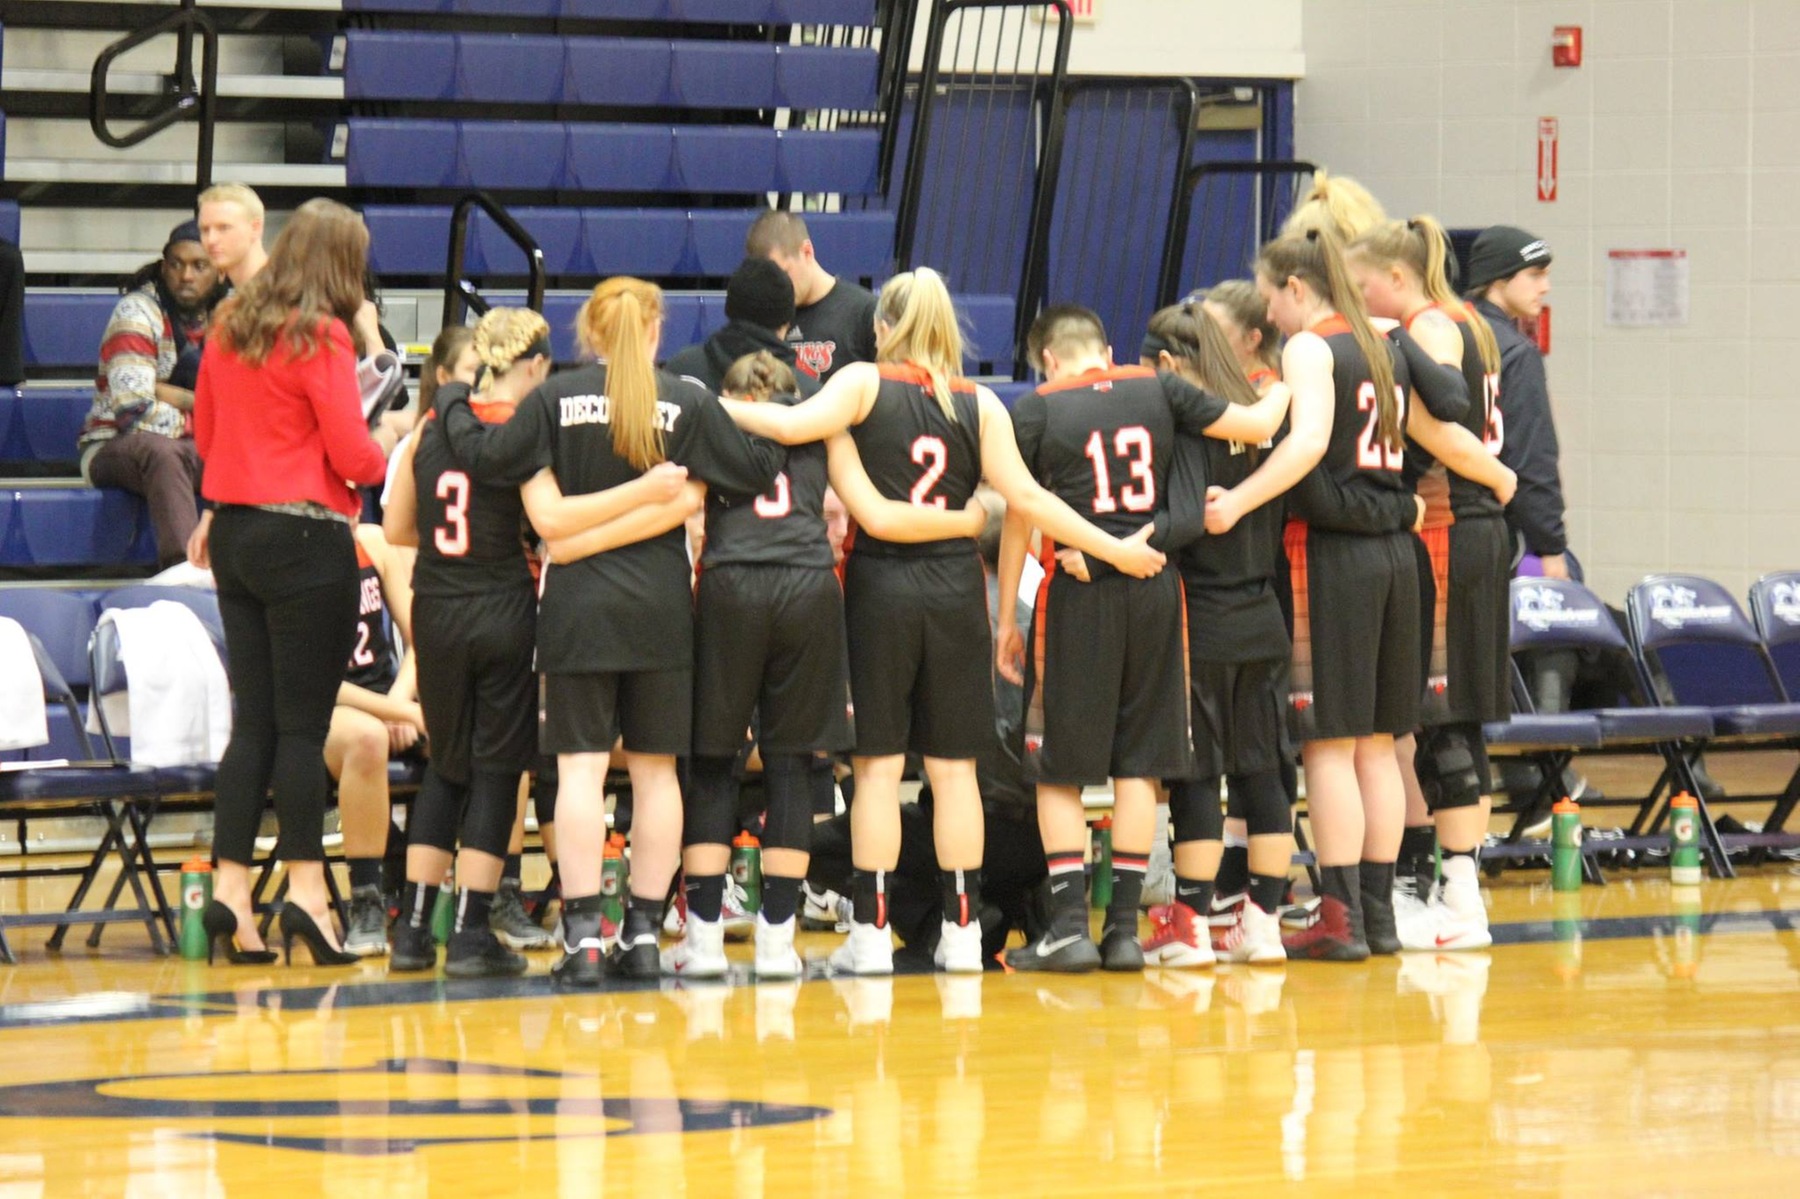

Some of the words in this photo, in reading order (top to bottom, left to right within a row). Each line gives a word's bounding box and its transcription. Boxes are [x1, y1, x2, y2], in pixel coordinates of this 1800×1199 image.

[910, 434, 948, 509] 2
[1085, 425, 1156, 513] 13
[434, 469, 471, 557] 3
[348, 620, 375, 666] 2
